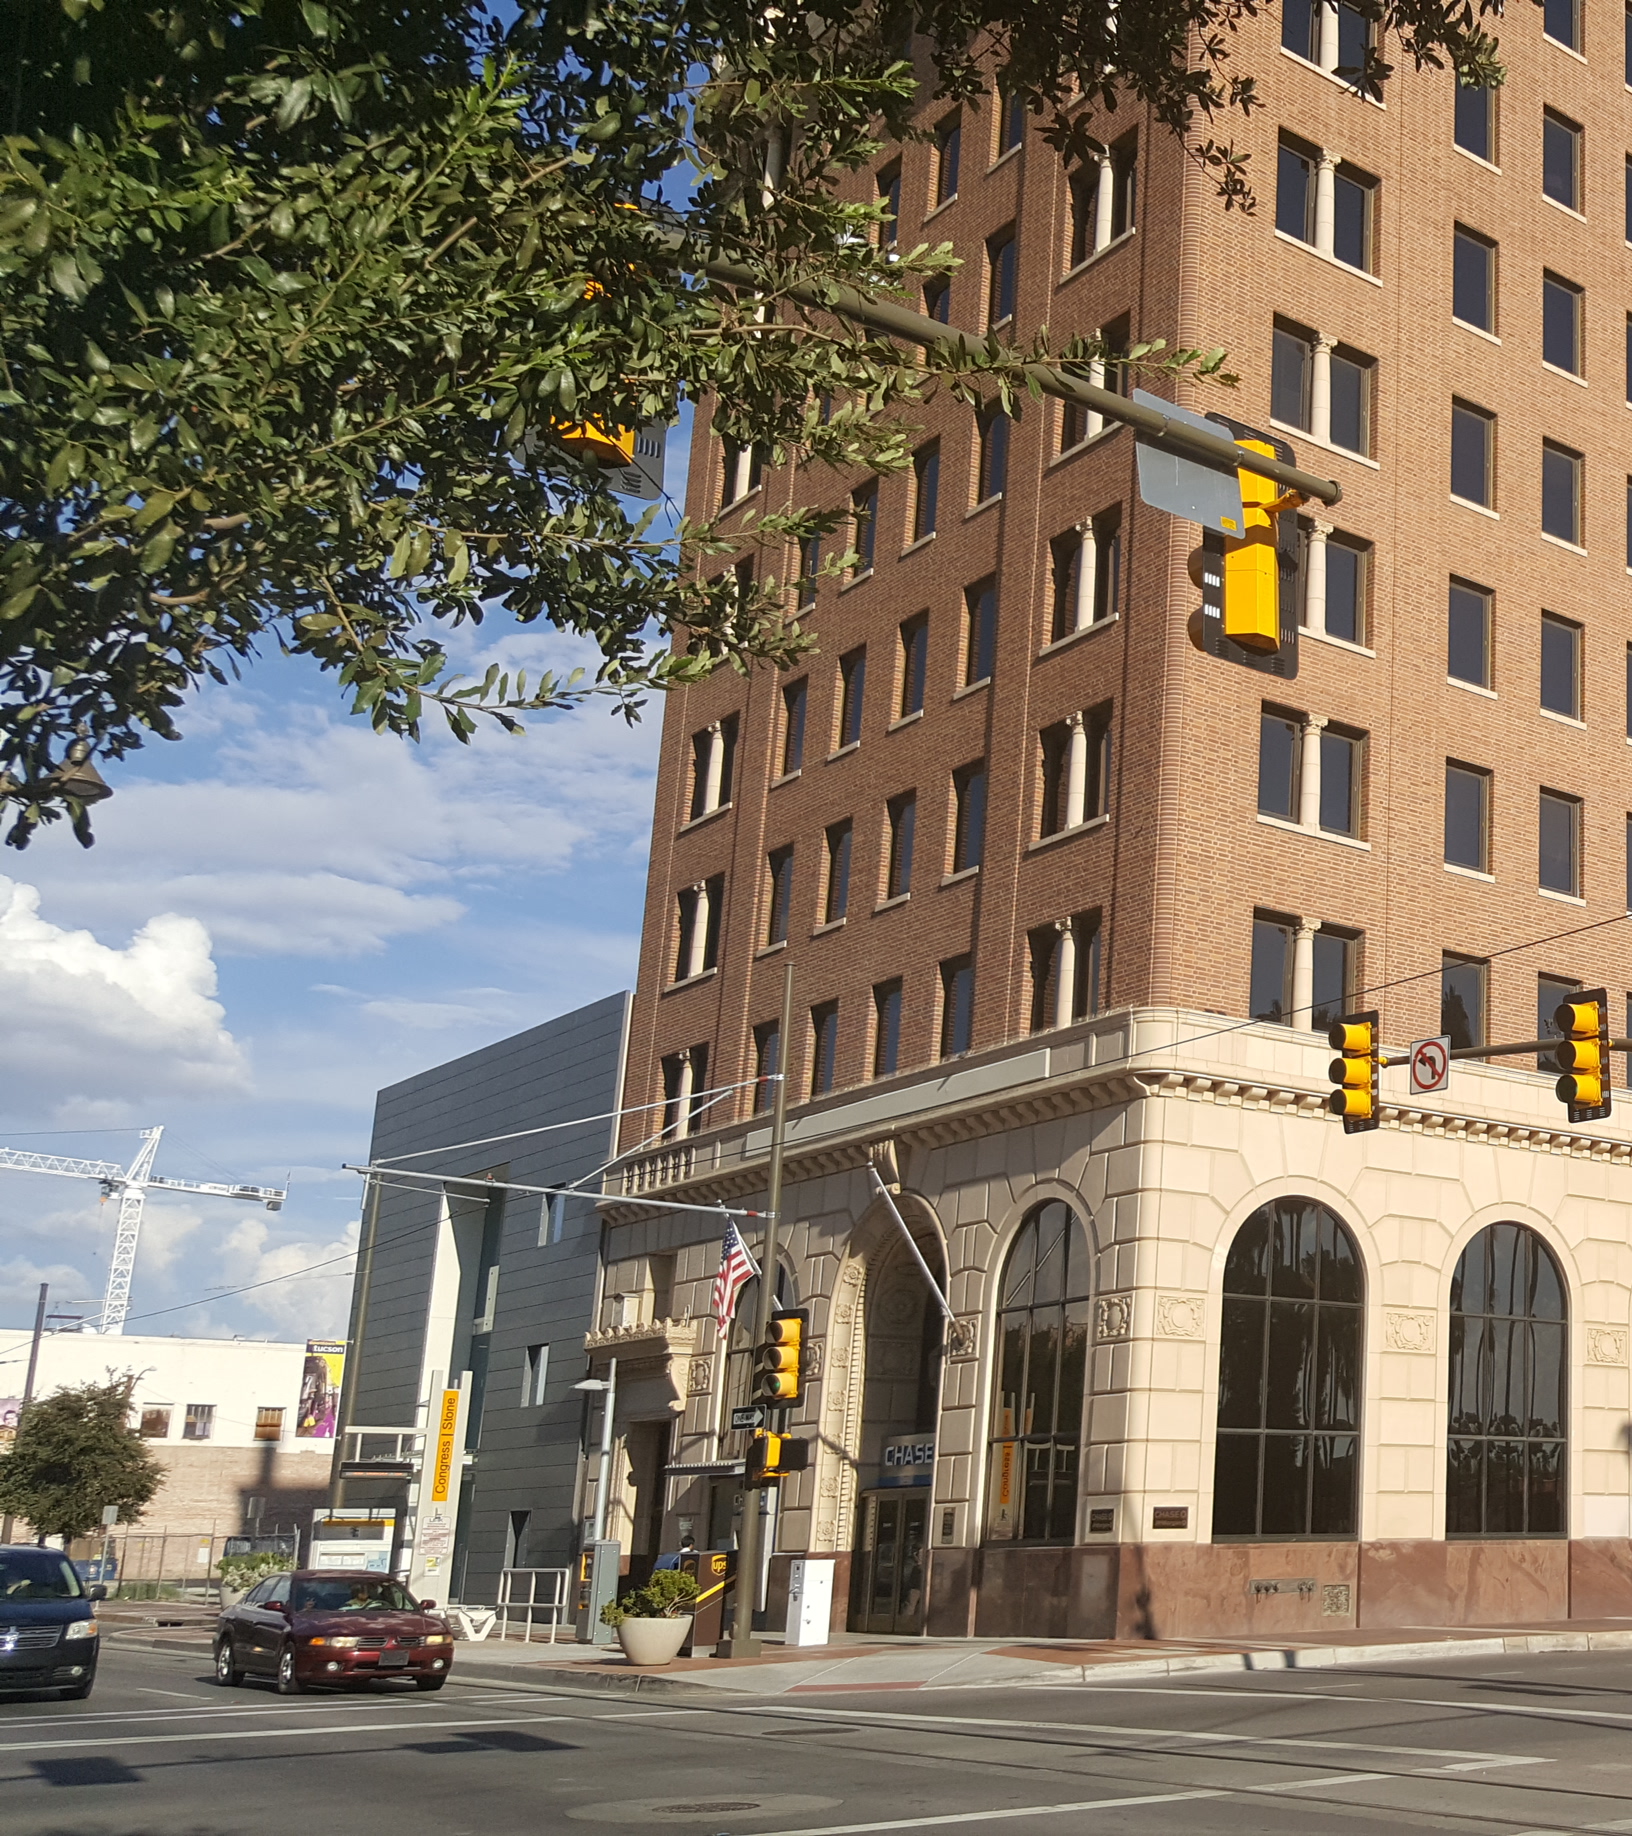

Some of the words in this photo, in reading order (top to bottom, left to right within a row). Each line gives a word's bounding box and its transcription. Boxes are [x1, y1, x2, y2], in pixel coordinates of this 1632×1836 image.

[313, 1345, 344, 1353] tucson
[442, 1397, 456, 1430] Stone
[885, 1443, 934, 1466] CHASE
[434, 1441, 451, 1494] Congress
[713, 1561, 727, 1573] ups
